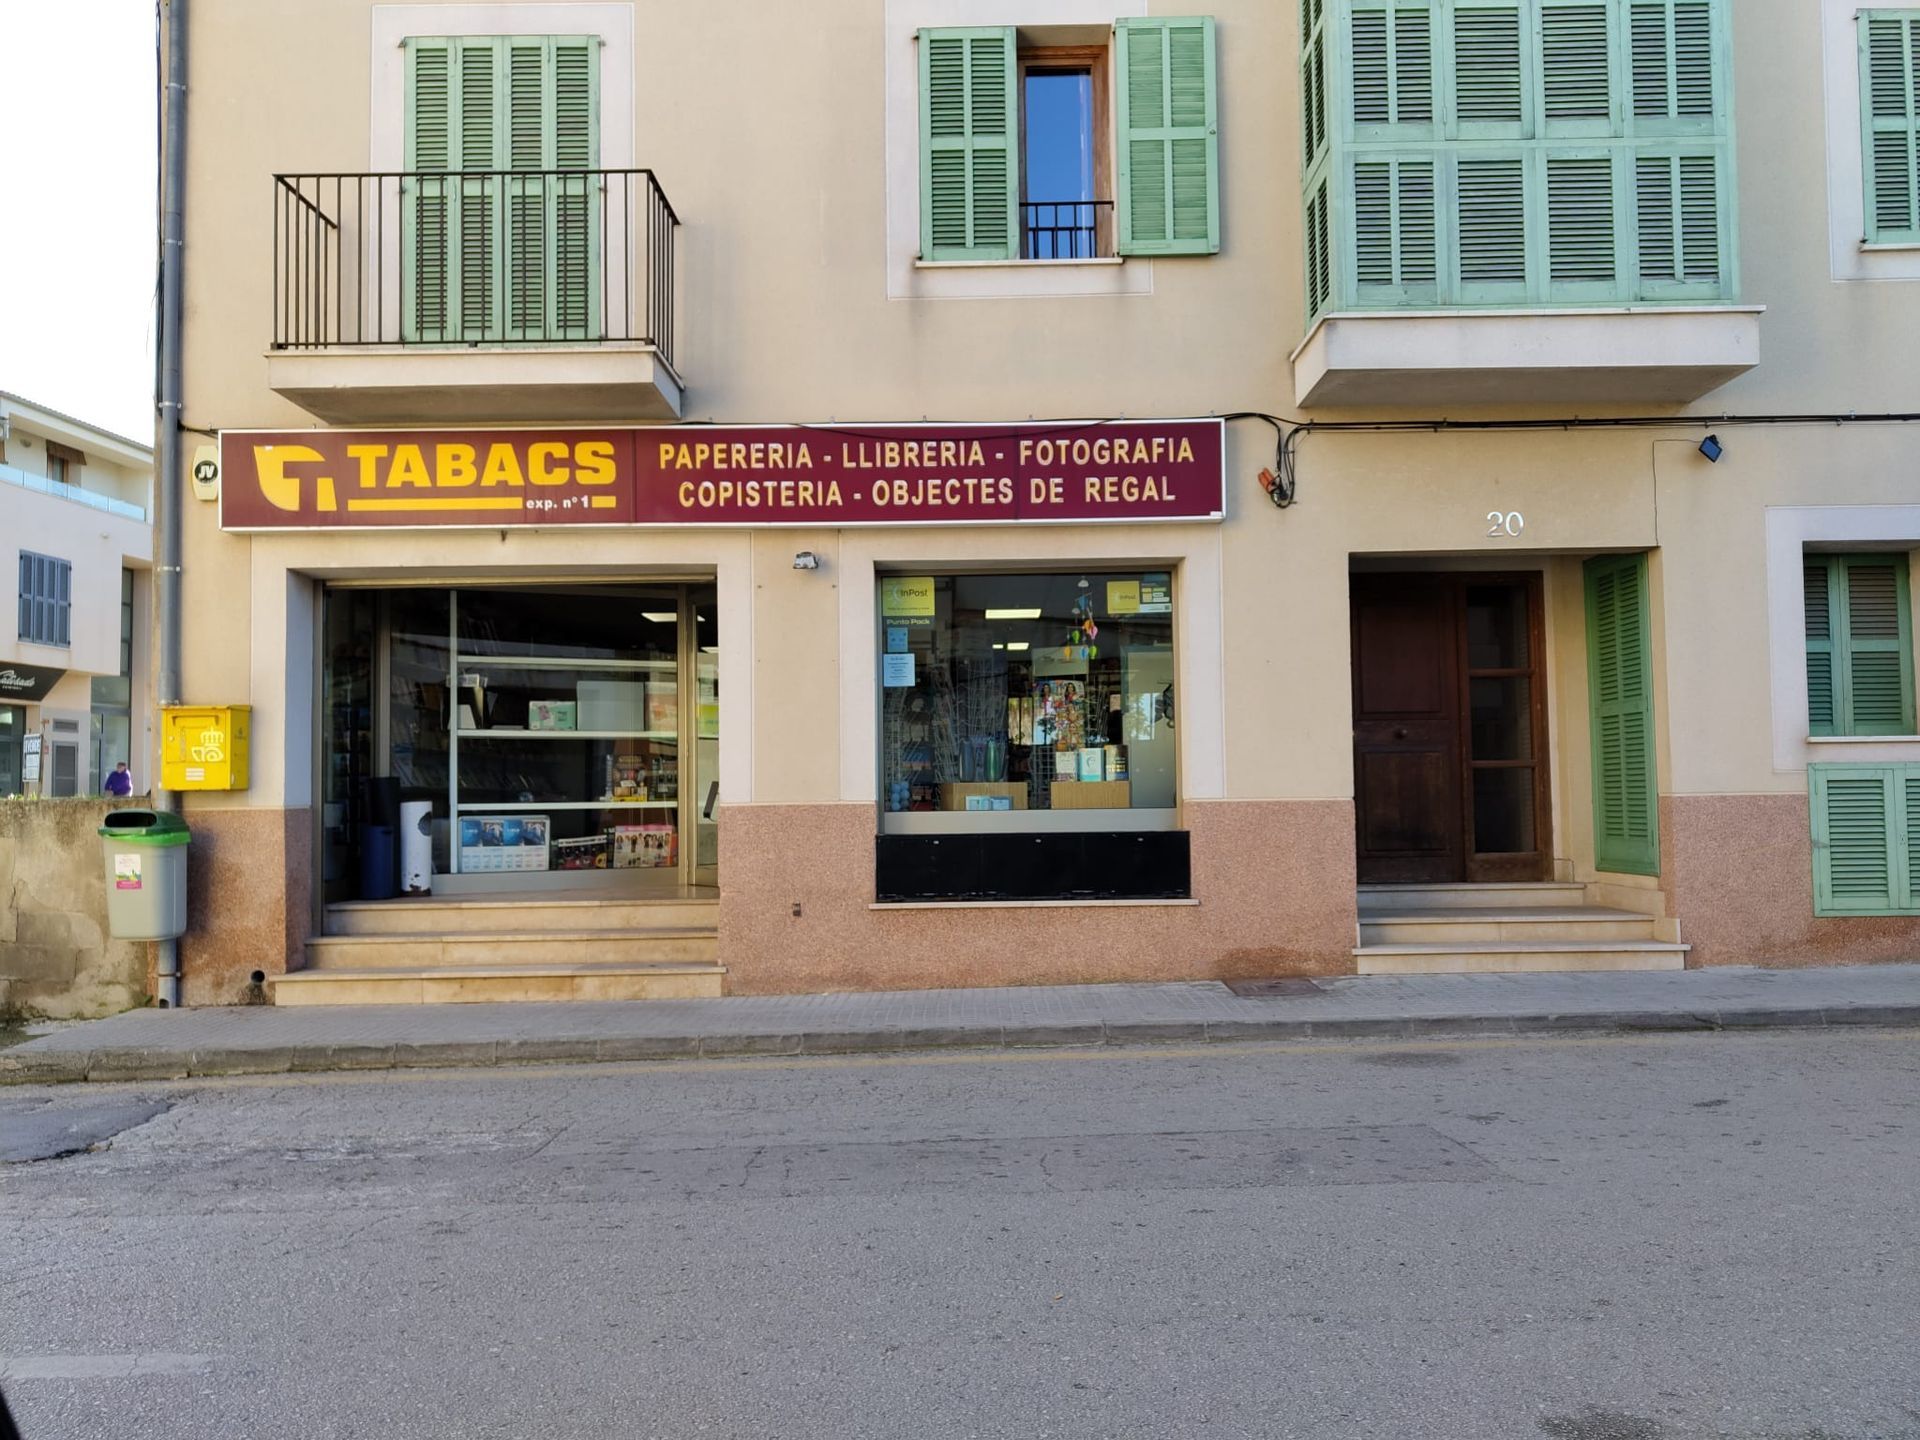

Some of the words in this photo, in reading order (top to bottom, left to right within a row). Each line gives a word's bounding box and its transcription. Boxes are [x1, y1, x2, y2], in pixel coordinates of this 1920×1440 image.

[346, 441, 617, 489] TABACS
[659, 442, 813, 470] PAPERERIA
[842, 440, 985, 468] LLIBRERIA
[1019, 437, 1194, 466] FOTOGRAFIA
[525, 499, 558, 512] exp.
[678, 480, 843, 508] COPISTERIA
[872, 477, 1014, 506] OBJECTES
[1030, 477, 1064, 504] DE
[1085, 476, 1176, 503] REGAL
[1486, 511, 1525, 537] 20
[900, 588, 929, 598] InPost
